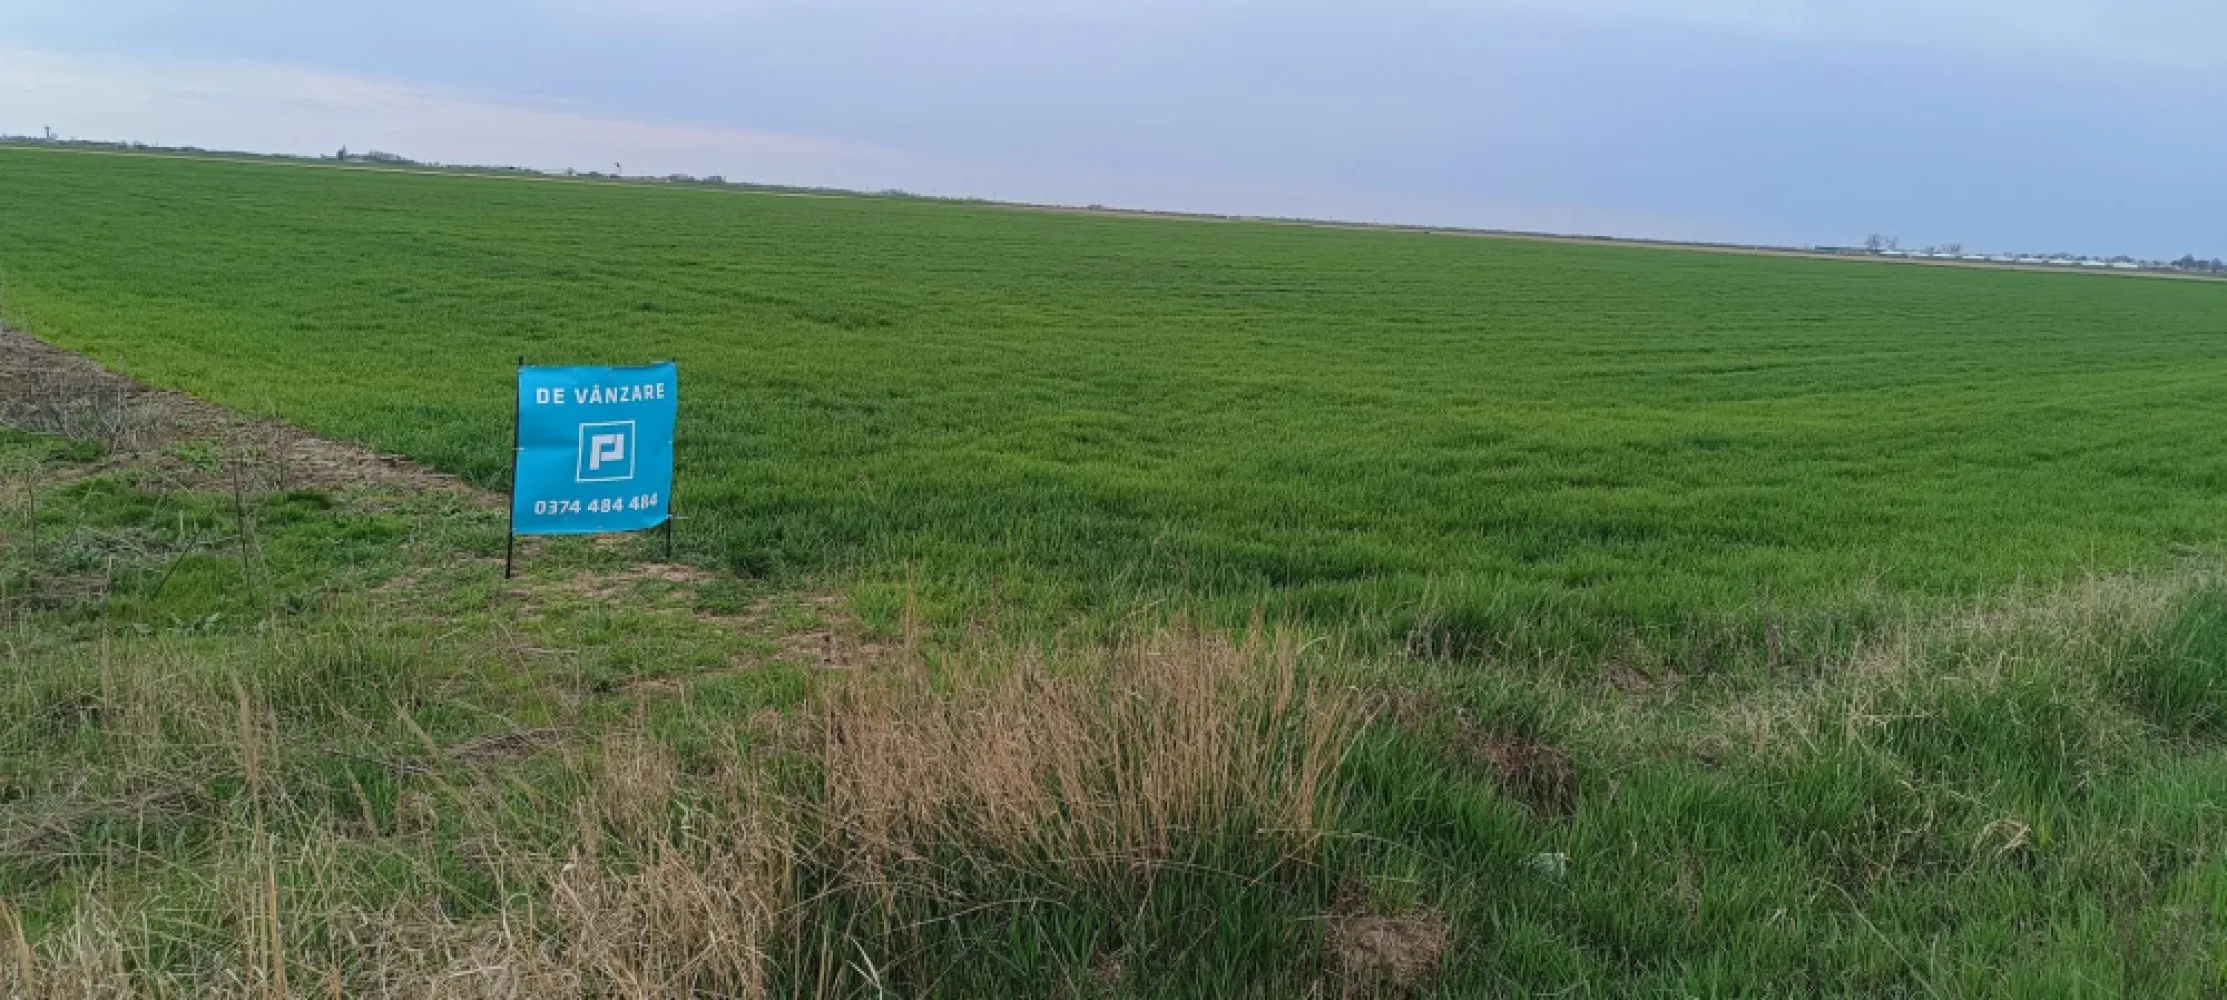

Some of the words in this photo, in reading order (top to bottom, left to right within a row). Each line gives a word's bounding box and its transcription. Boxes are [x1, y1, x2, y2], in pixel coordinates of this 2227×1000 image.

[536, 387, 565, 404] DE
[574, 383, 665, 404] VÂNZARE
[534, 499, 581, 515] 0374
[587, 497, 624, 513] 484
[628, 492, 658, 511] 484
